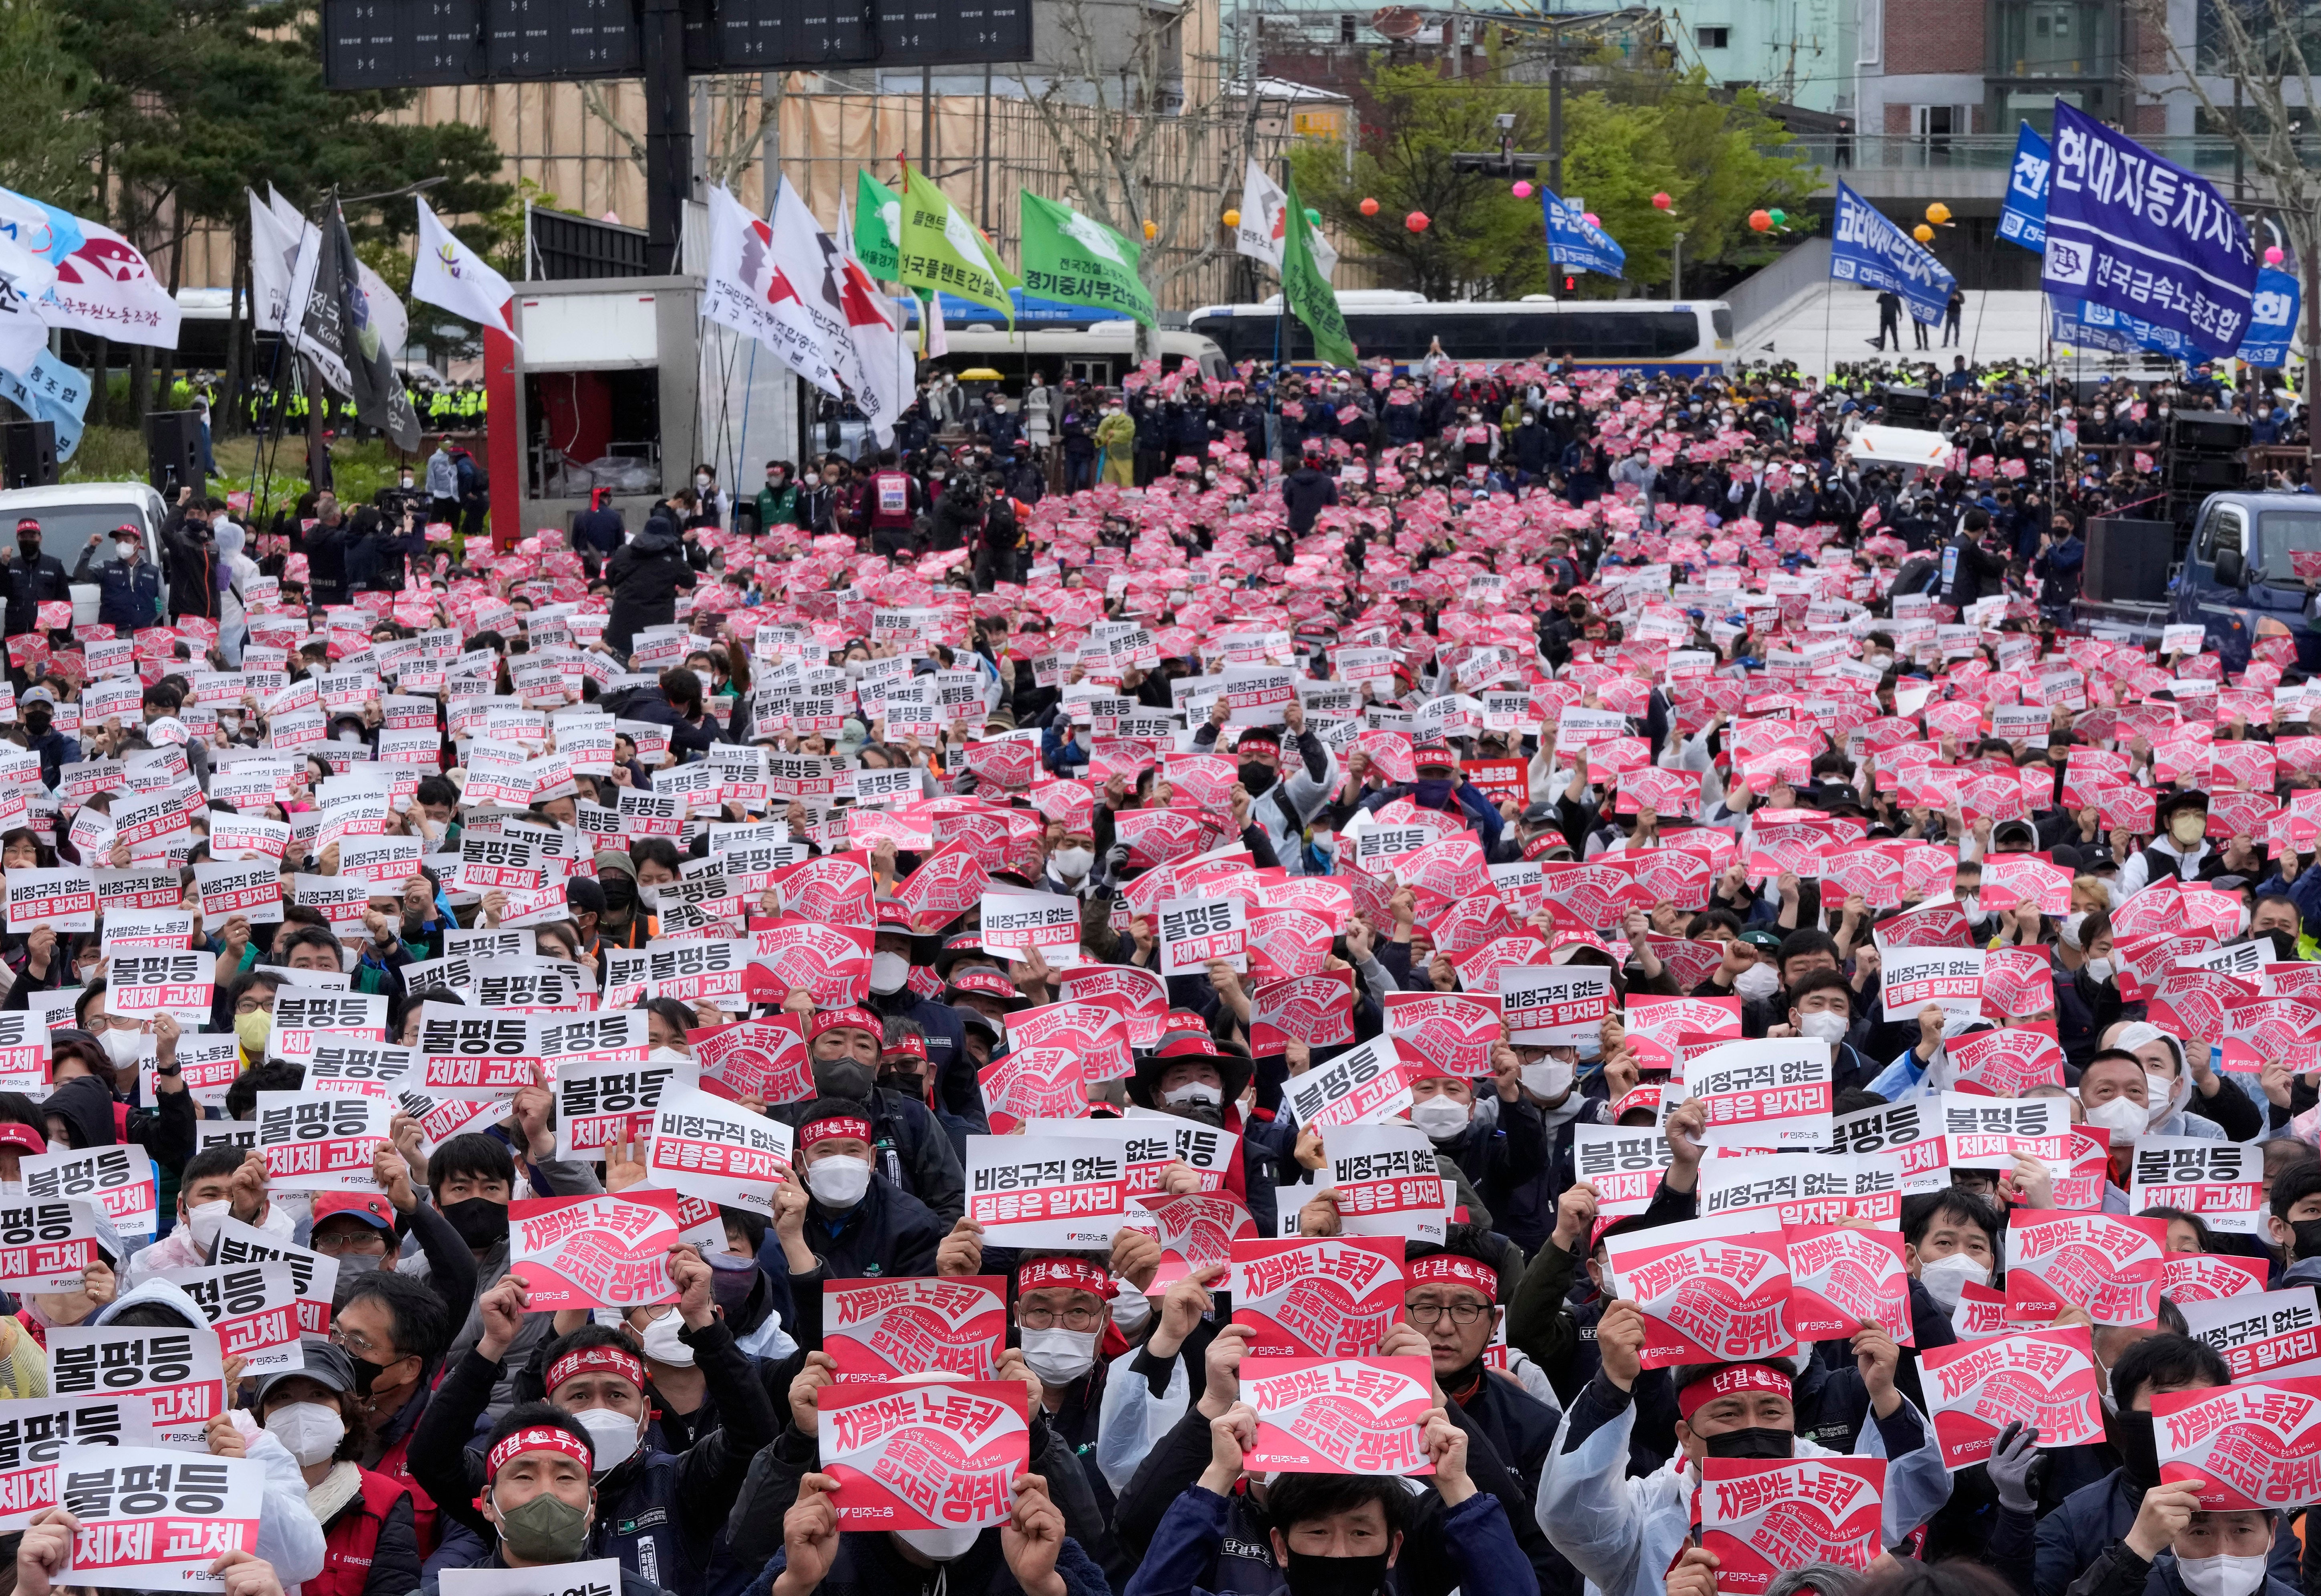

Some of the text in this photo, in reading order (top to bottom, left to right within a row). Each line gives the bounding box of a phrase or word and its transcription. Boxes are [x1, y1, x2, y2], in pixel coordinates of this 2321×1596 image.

[2013, 151, 2050, 200] 전
[2096, 252, 2241, 343] 전국금속노동조합
[2252, 291, 2292, 326] 회
[318, 323, 342, 349] Kore
[30, 365, 78, 404] 동조합
[1226, 674, 1289, 694] 비정규직 없는
[468, 773, 535, 789] 비정규직 없는
[769, 759, 828, 778] 불평등
[802, 779, 833, 795] 교체
[115, 797, 185, 829] 비정규직 없는
[620, 795, 677, 820] 불평등
[462, 839, 531, 868] 불평등
[1359, 829, 1425, 856] 불평등
[10, 878, 90, 902] 비정규직 없는
[201, 869, 276, 896] 비정규직 없는
[464, 865, 535, 889] 체제 교체
[12, 895, 92, 919] 질좋은 일자리
[986, 907, 1074, 928] 비정규직 없는
[1163, 903, 1231, 943] 불평등
[104, 920, 189, 939] 차별없는 노동권
[756, 927, 853, 959] 차별없는 노동권
[112, 954, 198, 986] 불평등
[650, 944, 732, 981] 불평등
[1887, 959, 1980, 985] 비정규직 없는
[117, 985, 206, 1009] 체제 교체
[1505, 979, 1604, 1009] 비정규직 없는
[1887, 979, 1979, 1008] 질좋은 일자리
[1392, 999, 1486, 1030] 차별없는 노동권
[1632, 1002, 1729, 1030] 차별없는 노동권
[2230, 1004, 2317, 1031] 차별없는 노동권
[422, 1019, 527, 1055] 불평등
[427, 1059, 536, 1086] 체제 교체
[1294, 1046, 1379, 1123] 불평등
[1692, 1059, 1825, 1099] 비정규직 없는
[1760, 1086, 1825, 1115] 일자리
[661, 1112, 786, 1158] 비정규직 없는
[803, 1120, 865, 1143] 단결 투쟁
[1945, 1104, 2049, 1135] 불평등
[658, 1140, 724, 1169] 질좋은
[1335, 1148, 1436, 1182] 비정규직 없는
[2136, 1147, 2243, 1183] 불평등
[975, 1156, 1117, 1192] 비정규직 없는
[975, 1186, 1117, 1223] 질좋은 일자리
[1708, 1172, 1848, 1212] 비정규직 없는
[521, 1203, 659, 1253] 차별없는 노동권
[1077, 1232, 1108, 1242] 민주노총
[2019, 1218, 2148, 1264] 차별없는 노동권
[562, 1241, 614, 1276] 질좋은
[1243, 1248, 1387, 1300] 차별없는 노동권
[1412, 1258, 1449, 1279] 단결
[552, 1255, 666, 1301] 일자리 쟁취!
[1627, 1248, 1769, 1303] 차별없는 노동권
[535, 1289, 570, 1302] 민주노총
[53, 1334, 193, 1394] 불평등
[549, 1352, 580, 1385] 단결
[607, 1351, 643, 1381] 투쟁
[1253, 1367, 1410, 1413] 차별없는 노동권
[833, 1392, 1005, 1453] 차별없는 노동권
[2166, 1391, 2315, 1450] 차별없는 노동권
[490, 1432, 522, 1469] 단결
[554, 1429, 589, 1465] 투쟁
[883, 1438, 948, 1488] 질좋은
[904, 1429, 924, 1443] 윤석열
[925, 1438, 942, 1452] 당선인은
[942, 1450, 960, 1463] 노동자의
[961, 1458, 982, 1469] 목소리를
[63, 1464, 229, 1518] 불평등
[871, 1457, 1012, 1523] 일자리 쟁취!
[851, 1506, 894, 1518] 민주노총
[75, 1523, 243, 1565] 체제 교체
[1224, 1539, 1272, 1564] 단결투쟁
